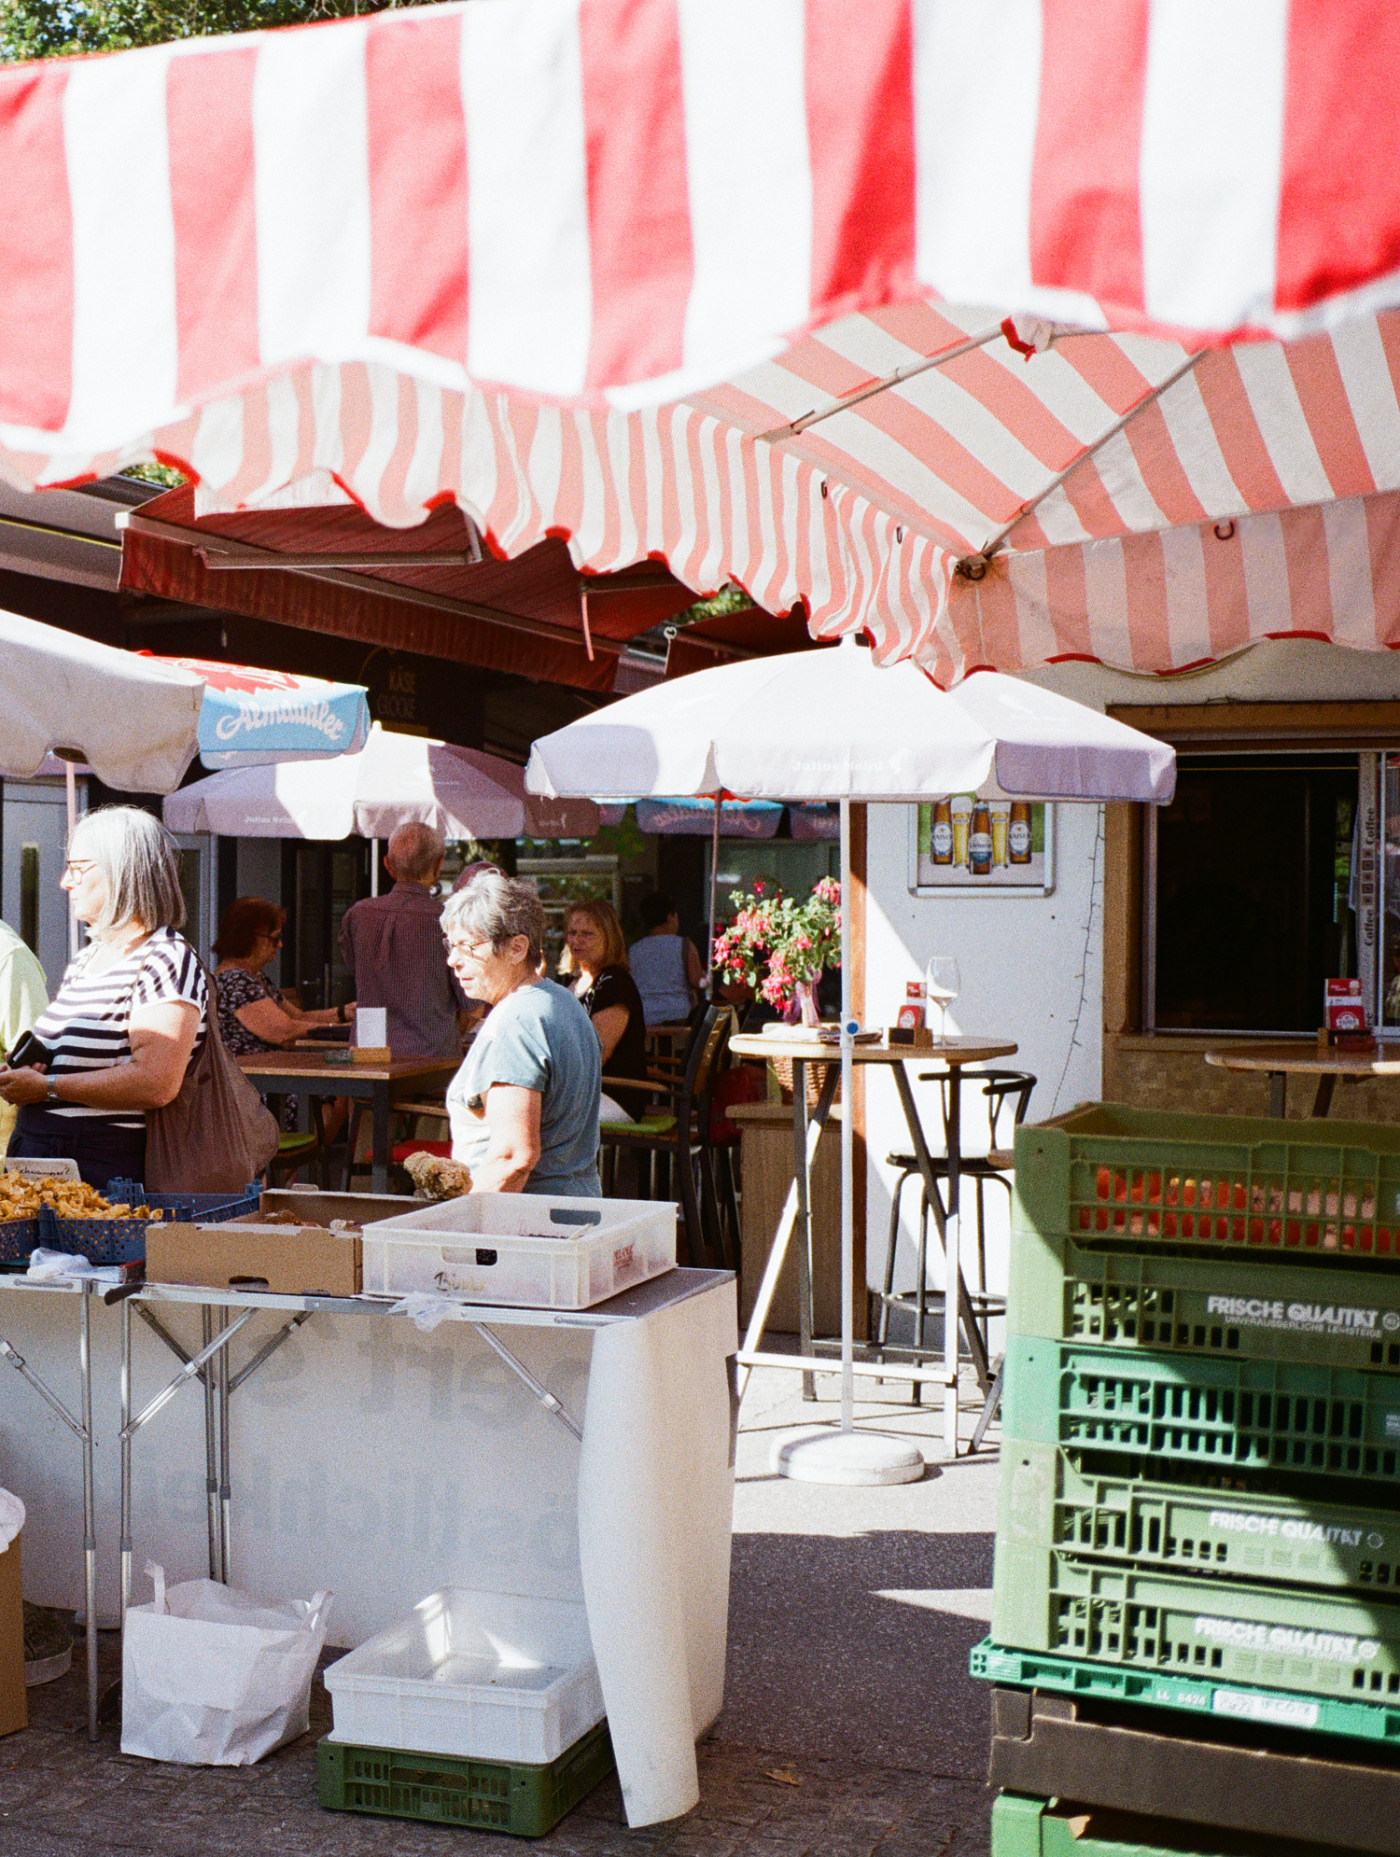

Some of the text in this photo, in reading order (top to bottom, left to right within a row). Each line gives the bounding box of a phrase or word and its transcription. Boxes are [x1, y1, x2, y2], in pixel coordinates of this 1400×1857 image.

[1365, 807, 1375, 845] Coffee
[1364, 909, 1374, 946] Coffee
[1207, 1295, 1284, 1320] FRISCHE
[1209, 1511, 1280, 1536] FRISCHE
[1194, 1616, 1267, 1644] FRISCHE
